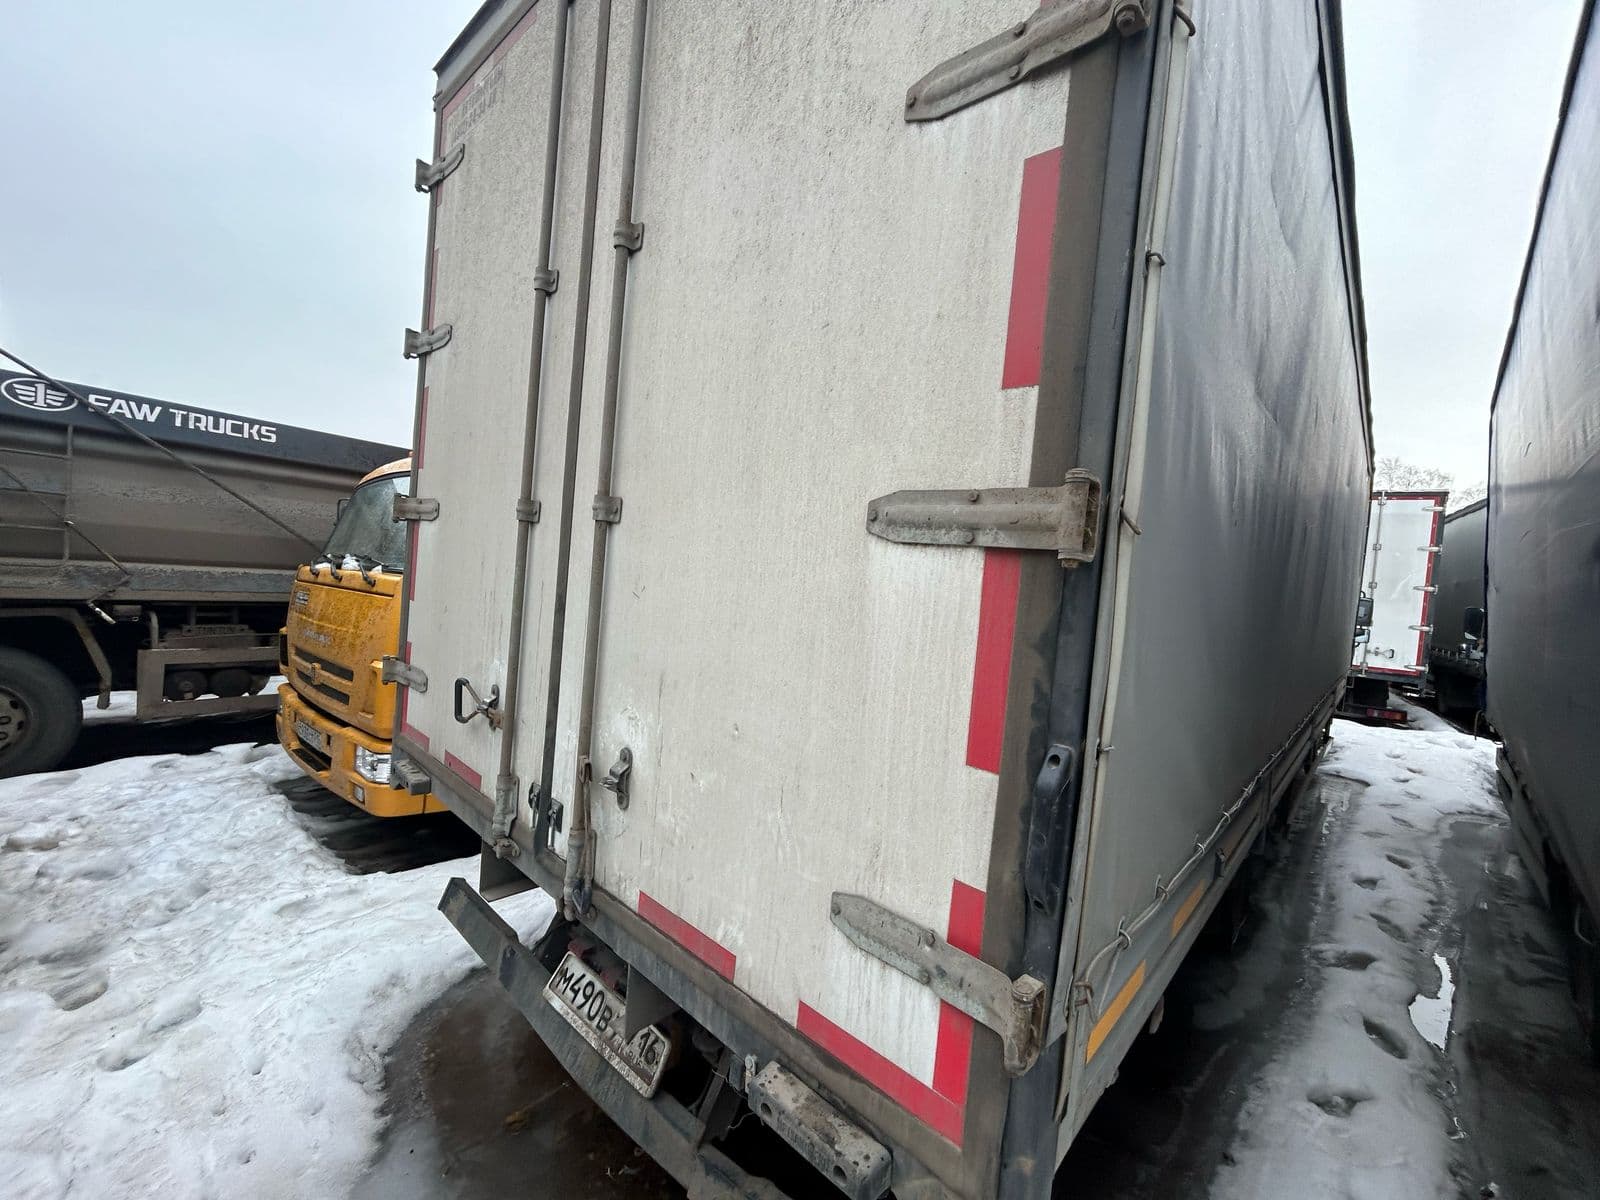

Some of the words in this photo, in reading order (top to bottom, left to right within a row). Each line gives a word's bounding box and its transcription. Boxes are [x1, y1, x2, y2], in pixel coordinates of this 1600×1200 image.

[88, 394, 162, 423] FAW
[168, 408, 278, 444] TRUCKS
[556, 966, 620, 1038] М490В
